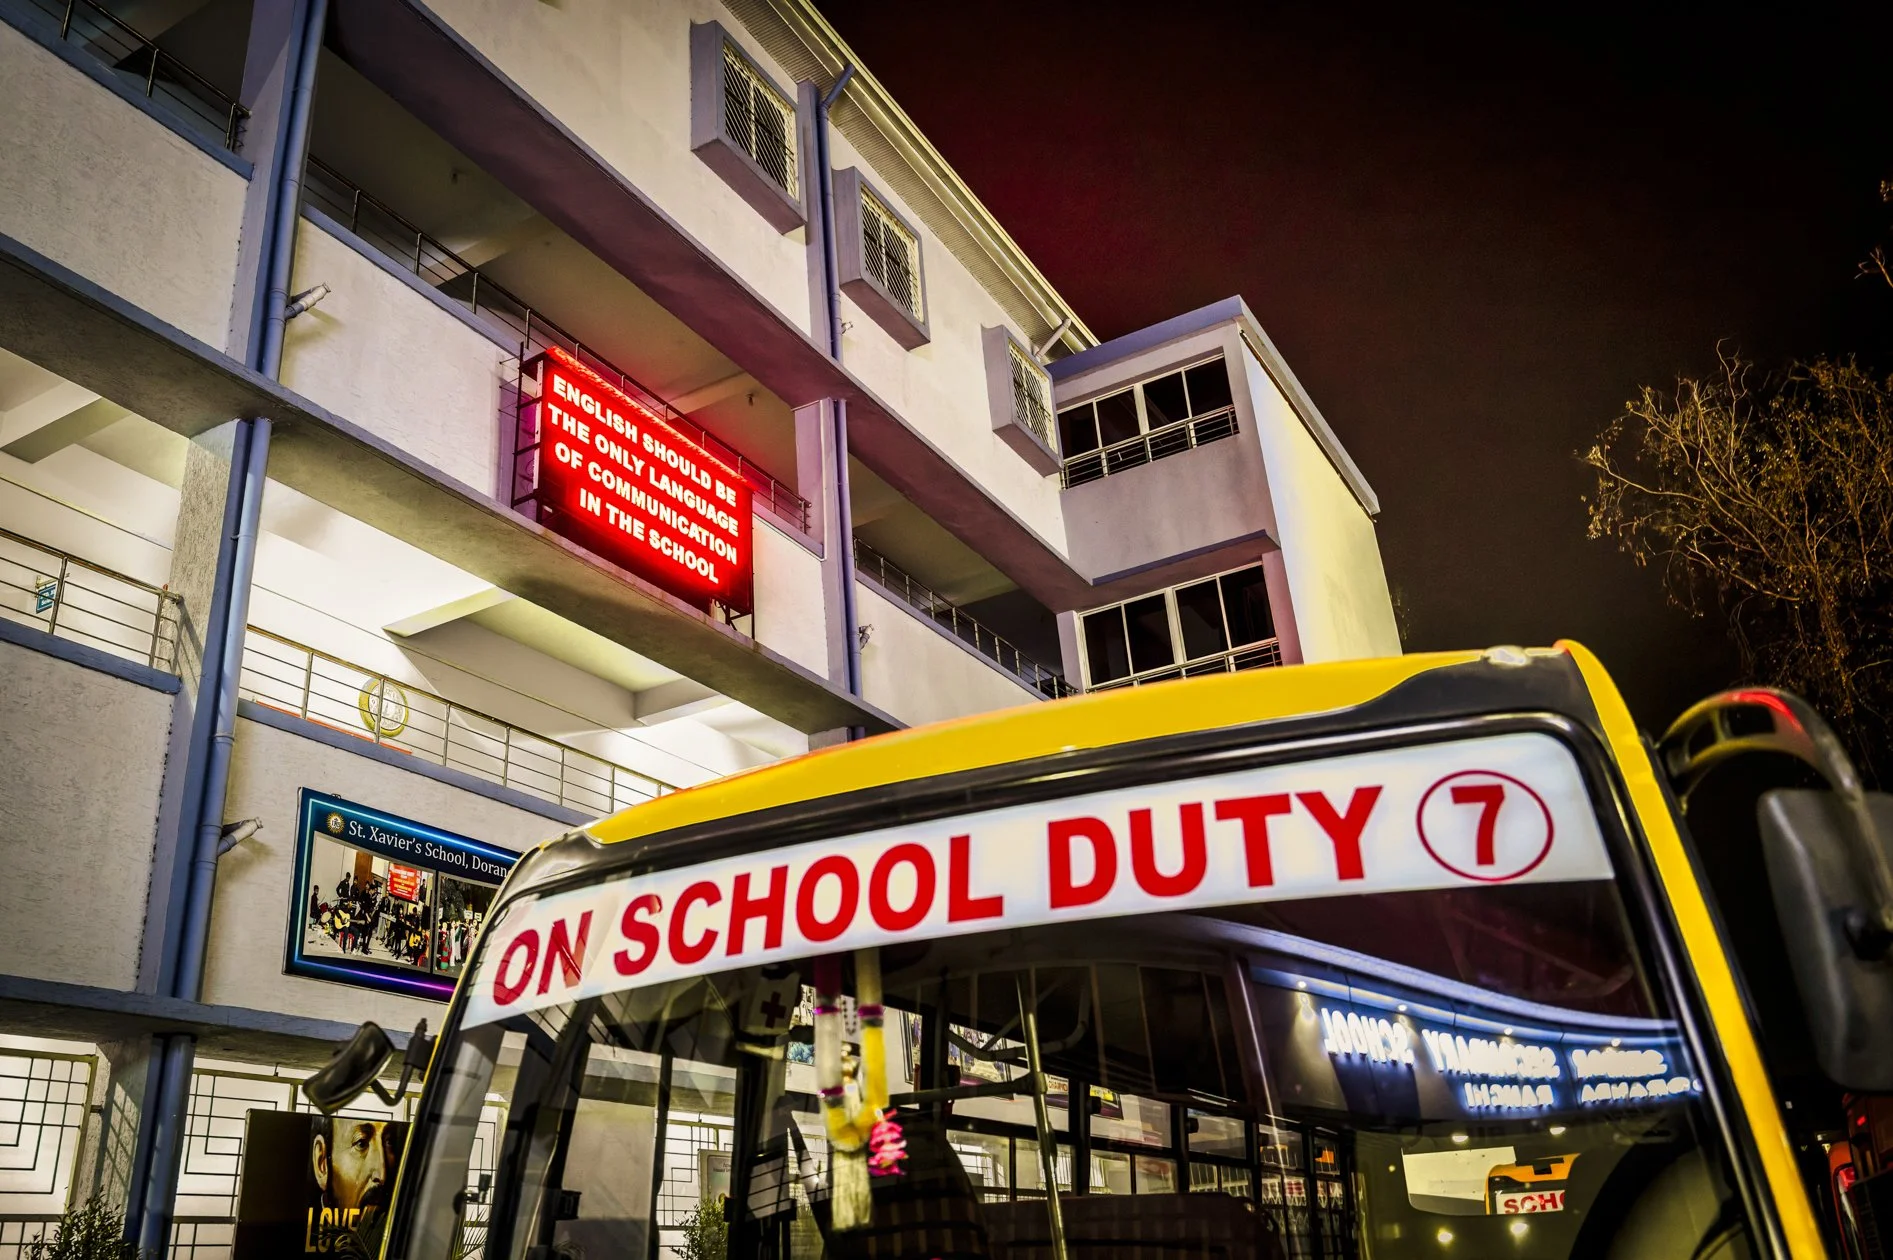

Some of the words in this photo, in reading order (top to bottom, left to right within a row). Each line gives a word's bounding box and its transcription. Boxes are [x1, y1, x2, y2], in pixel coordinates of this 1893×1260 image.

[548, 403, 590, 444] THE
[594, 434, 645, 477] ONLY
[649, 466, 739, 537] LANGUAGE
[553, 374, 638, 444] ENGLISH
[642, 433, 712, 490] SHOULD
[715, 480, 737, 508] BE
[555, 442, 583, 470] OF
[588, 462, 737, 565] COMMUNICATION
[580, 488, 601, 517] IN
[606, 503, 645, 541] THE
[648, 529, 719, 584] SCHOOL
[348, 820, 366, 839] St.
[369, 825, 422, 855] Xavier's
[425, 842, 469, 869] School,
[472, 855, 511, 878] Doran
[493, 911, 594, 1006] ON
[614, 834, 1004, 977] SCHOOL
[1047, 785, 1384, 911] DUTY
[1450, 784, 1507, 866] 7
